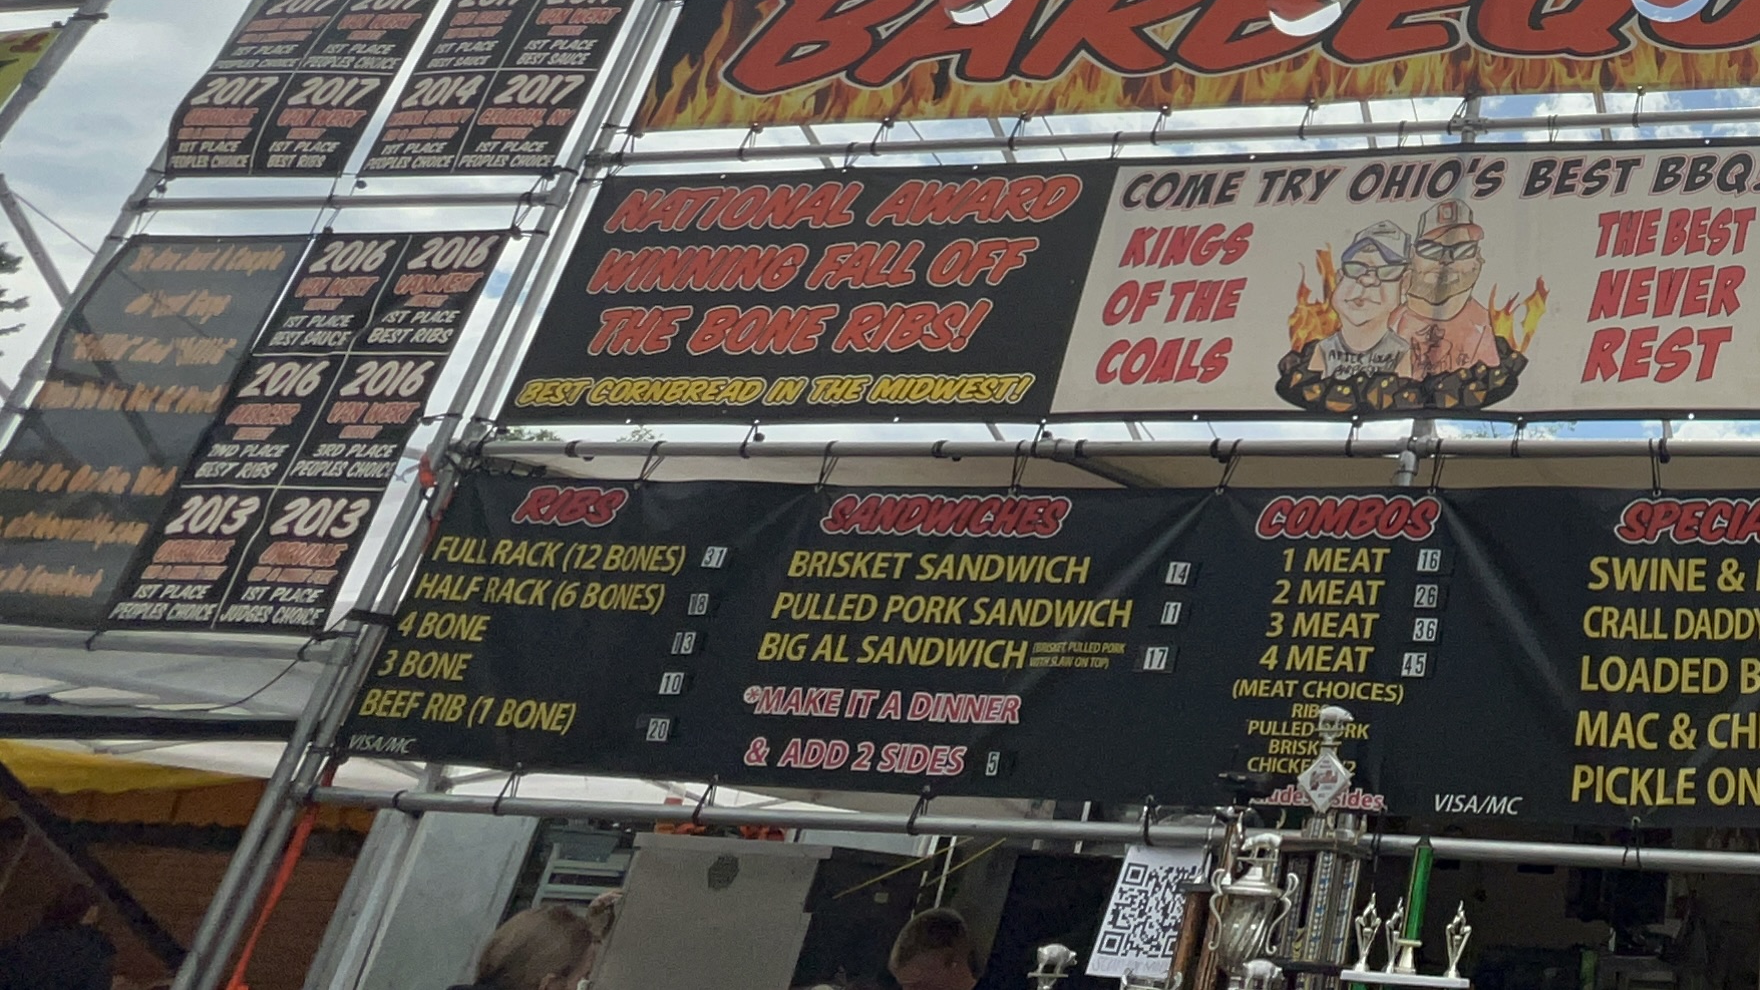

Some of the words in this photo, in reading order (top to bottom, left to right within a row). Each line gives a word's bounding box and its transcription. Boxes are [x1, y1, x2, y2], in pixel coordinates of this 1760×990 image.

[493, 74, 585, 105] 2017
[1121, 169, 1241, 210] COME
[1256, 166, 1344, 204] TRY
[1347, 155, 1506, 201] OHIO'S
[1519, 156, 1641, 199] BEST
[603, 180, 865, 234] NATIONAL
[867, 175, 1084, 227] AWARD
[407, 235, 499, 269] 2016
[1119, 222, 1254, 269] KINGS
[1594, 211, 1660, 259] THE
[1661, 207, 1758, 257] BEST
[587, 243, 807, 295] WINNING
[805, 239, 926, 291] FALL
[928, 237, 1040, 287] OFF
[1103, 280, 1166, 327] OF
[1166, 277, 1247, 322] THE
[1584, 264, 1746, 322] NEVER
[367, 328, 413, 343] BEST
[410, 328, 454, 343] RIBS
[587, 304, 693, 356] THE
[687, 303, 839, 356] BONE
[831, 298, 993, 354] RIBS!
[1094, 338, 1230, 385] COALS
[1580, 326, 1735, 384] REST
[514, 378, 590, 408] BEST
[588, 377, 765, 407] CORNBREAD
[767, 376, 806, 405] IN
[807, 374, 874, 405] THE
[873, 374, 1036, 404] MIDWEST!
[512, 486, 629, 527] RIBS
[820, 493, 1073, 538] SANDWICHES
[1256, 494, 1441, 540] COMBOS
[432, 536, 489, 563] FULL
[492, 539, 564, 568] RACK
[562, 543, 602, 573] (12
[604, 544, 686, 575] BONES)
[701, 546, 728, 568] 31
[788, 550, 911, 579] BRISKET
[915, 553, 1090, 584] SANDWICH
[1282, 548, 1296, 572] 1
[1304, 548, 1390, 573] MEAT
[1417, 549, 1441, 571] 16
[1588, 557, 1707, 592] SWINE
[1716, 558, 1745, 592] &
[1272, 579, 1291, 605] 2
[1298, 580, 1385, 606] MEAT
[1414, 585, 1438, 608] 26
[1580, 656, 1728, 694] LOADED
[348, 734, 416, 754] VISA/MC
[1435, 794, 1523, 815] VISA/MC
